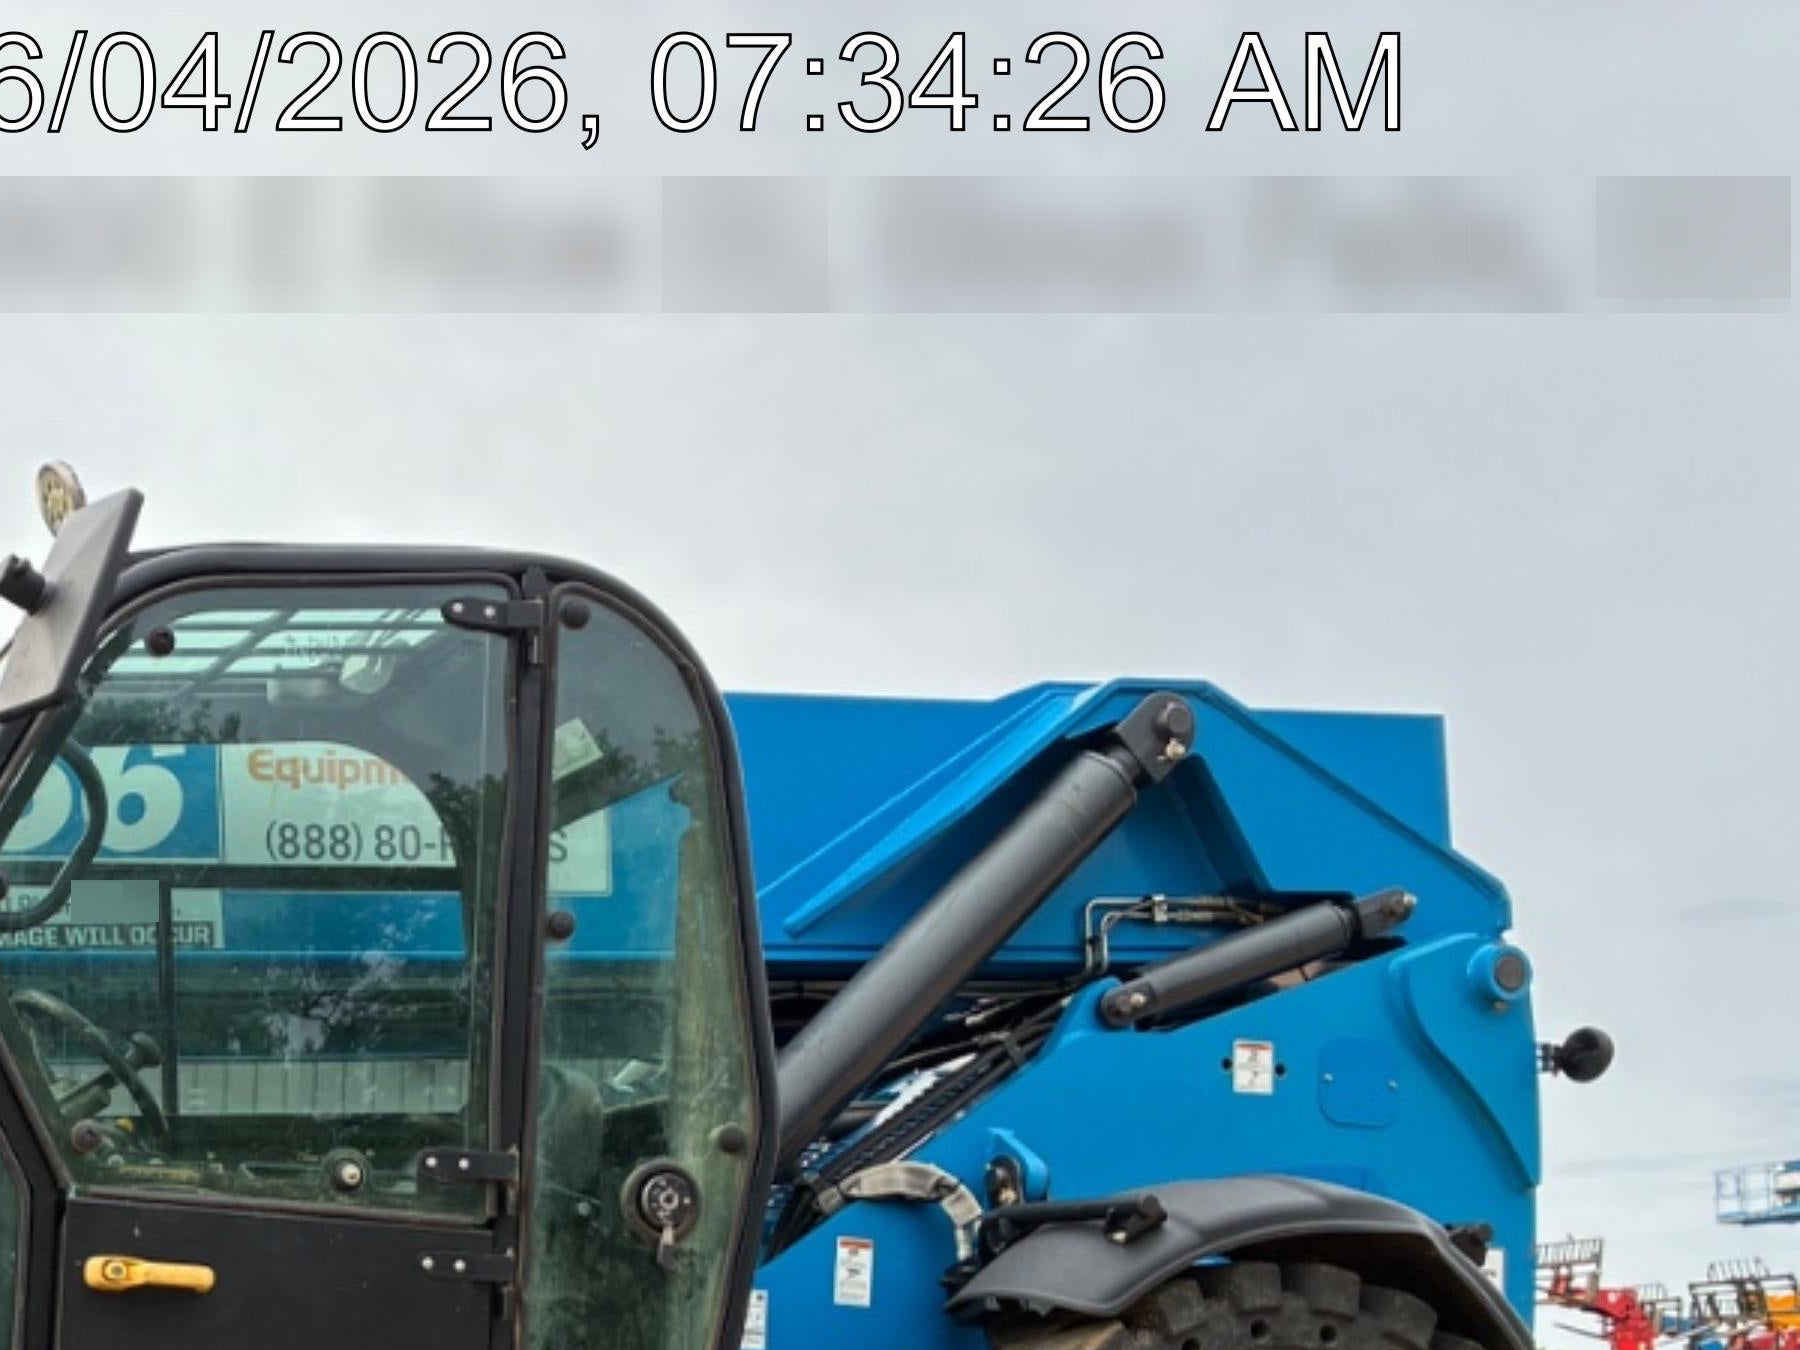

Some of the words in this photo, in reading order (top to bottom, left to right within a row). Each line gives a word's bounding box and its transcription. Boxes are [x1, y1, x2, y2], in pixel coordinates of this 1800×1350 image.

[247, 748, 402, 790] Equipm
[265, 819, 362, 864] (888)
[65, 926, 124, 945] WILL
